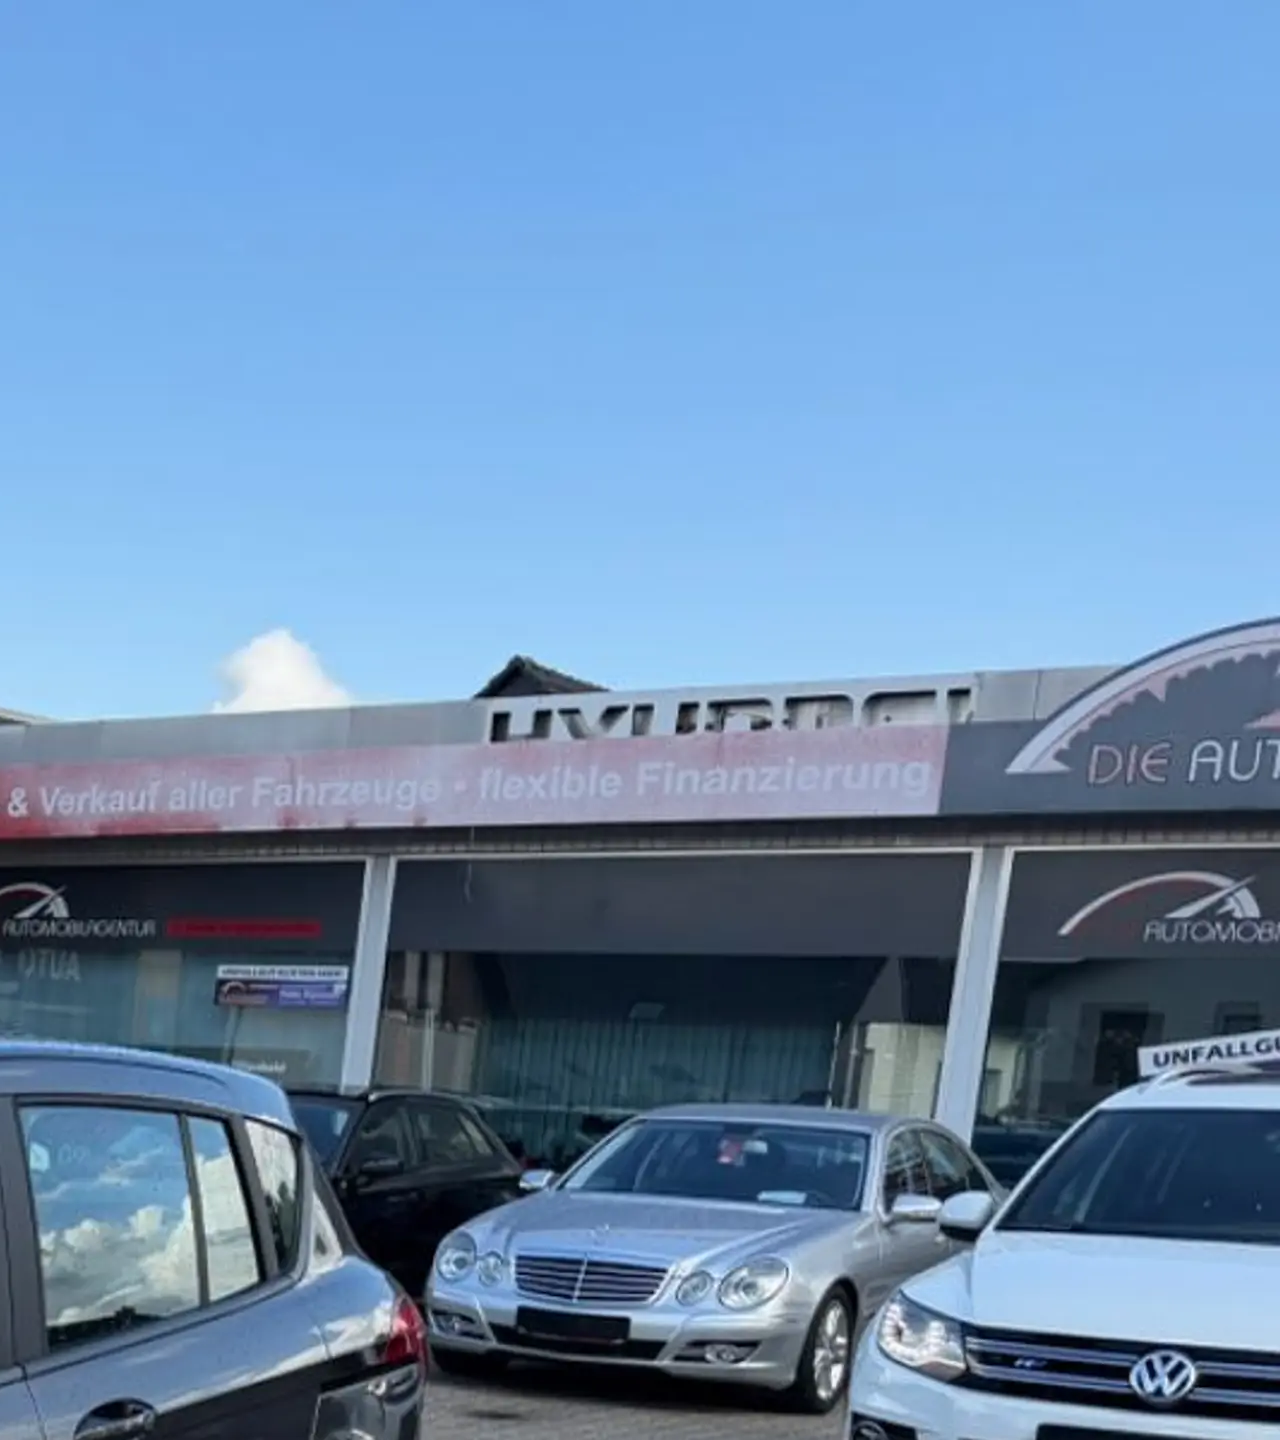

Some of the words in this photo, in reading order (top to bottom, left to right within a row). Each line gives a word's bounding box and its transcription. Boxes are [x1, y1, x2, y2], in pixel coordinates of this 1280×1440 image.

[1088, 743, 1172, 785] DIE
[7, 786, 29, 819] &
[40, 781, 162, 816] Verkauf
[169, 777, 244, 812] aller
[252, 775, 438, 812] Fahrzeuge
[479, 766, 623, 801] flexible
[636, 758, 934, 798] Finanzierung
[1152, 1036, 1280, 1067] UNFALLG
